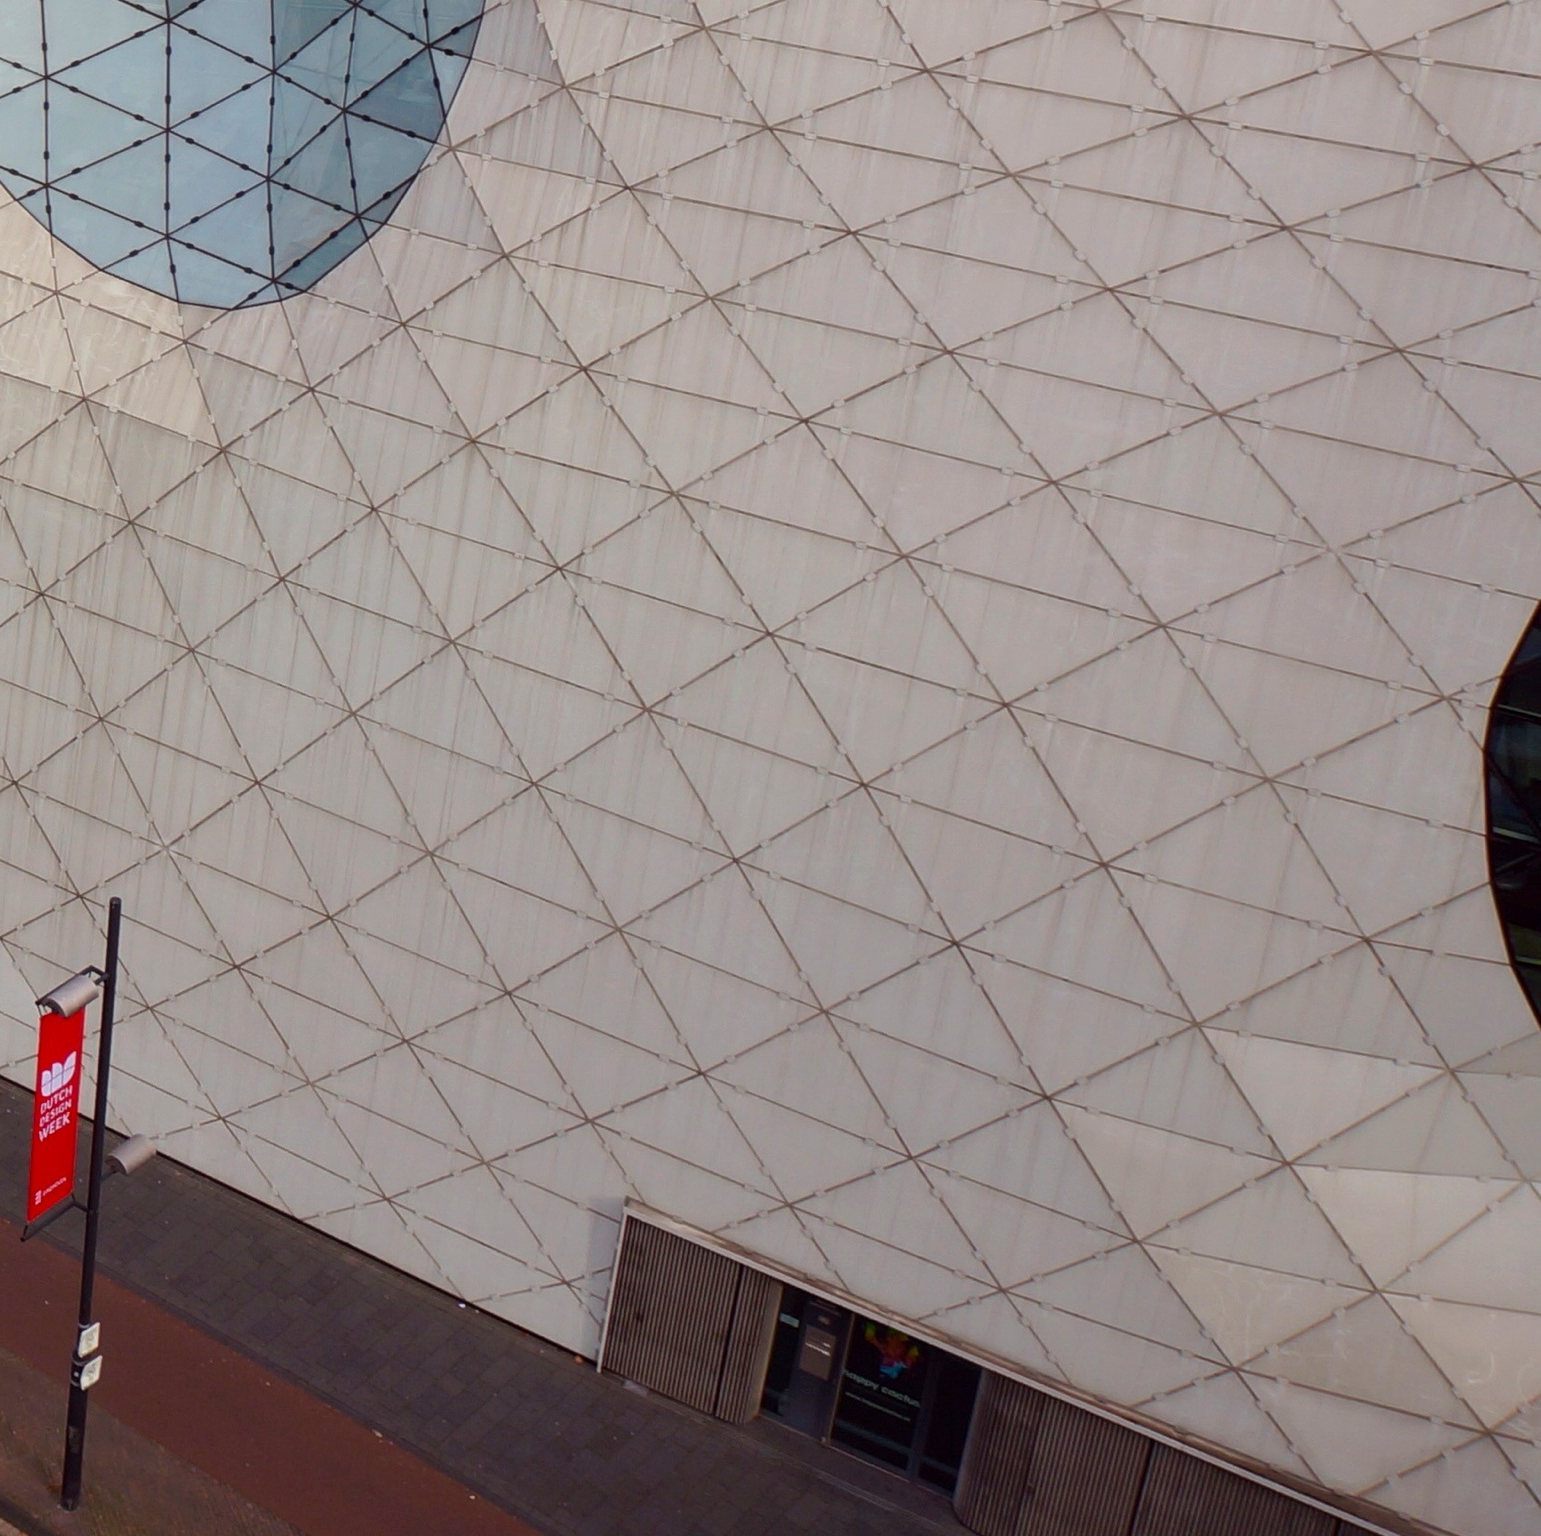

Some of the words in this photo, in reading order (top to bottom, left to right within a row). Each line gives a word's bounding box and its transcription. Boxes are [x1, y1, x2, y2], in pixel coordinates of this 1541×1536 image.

[39, 1099, 72, 1128] DESIGN
[40, 1084, 72, 1114] DUTCH
[38, 1111, 71, 1143] WEEK
